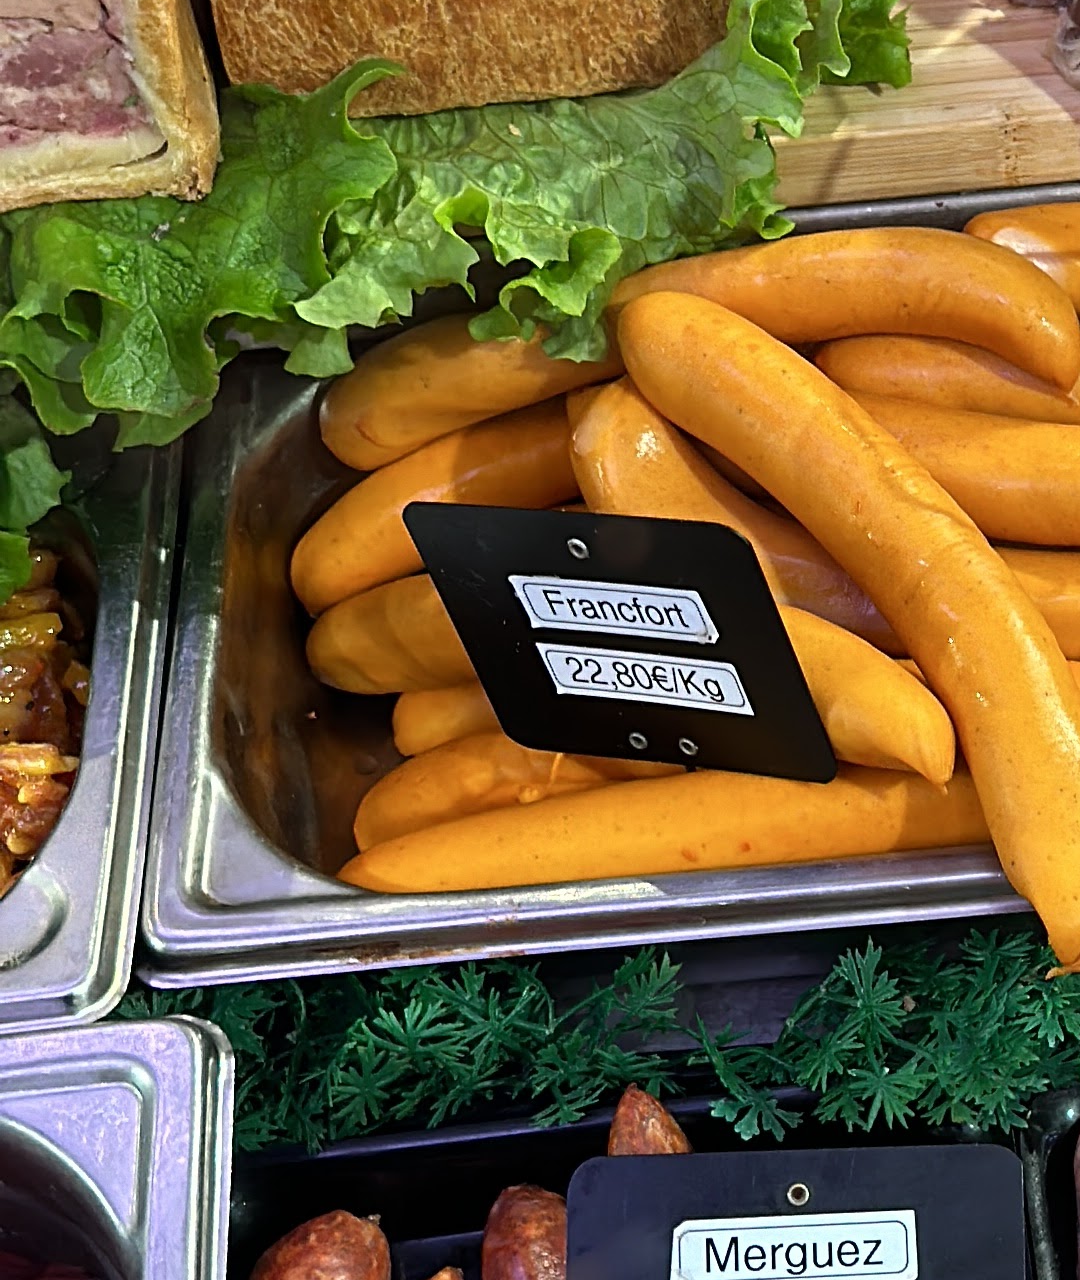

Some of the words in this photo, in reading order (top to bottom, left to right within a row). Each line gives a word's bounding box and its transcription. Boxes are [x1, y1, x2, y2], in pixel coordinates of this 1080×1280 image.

[542, 588, 690, 629] Francfort
[565, 656, 726, 704] 22,80€/Kg
[704, 1236, 884, 1276] Merguez
